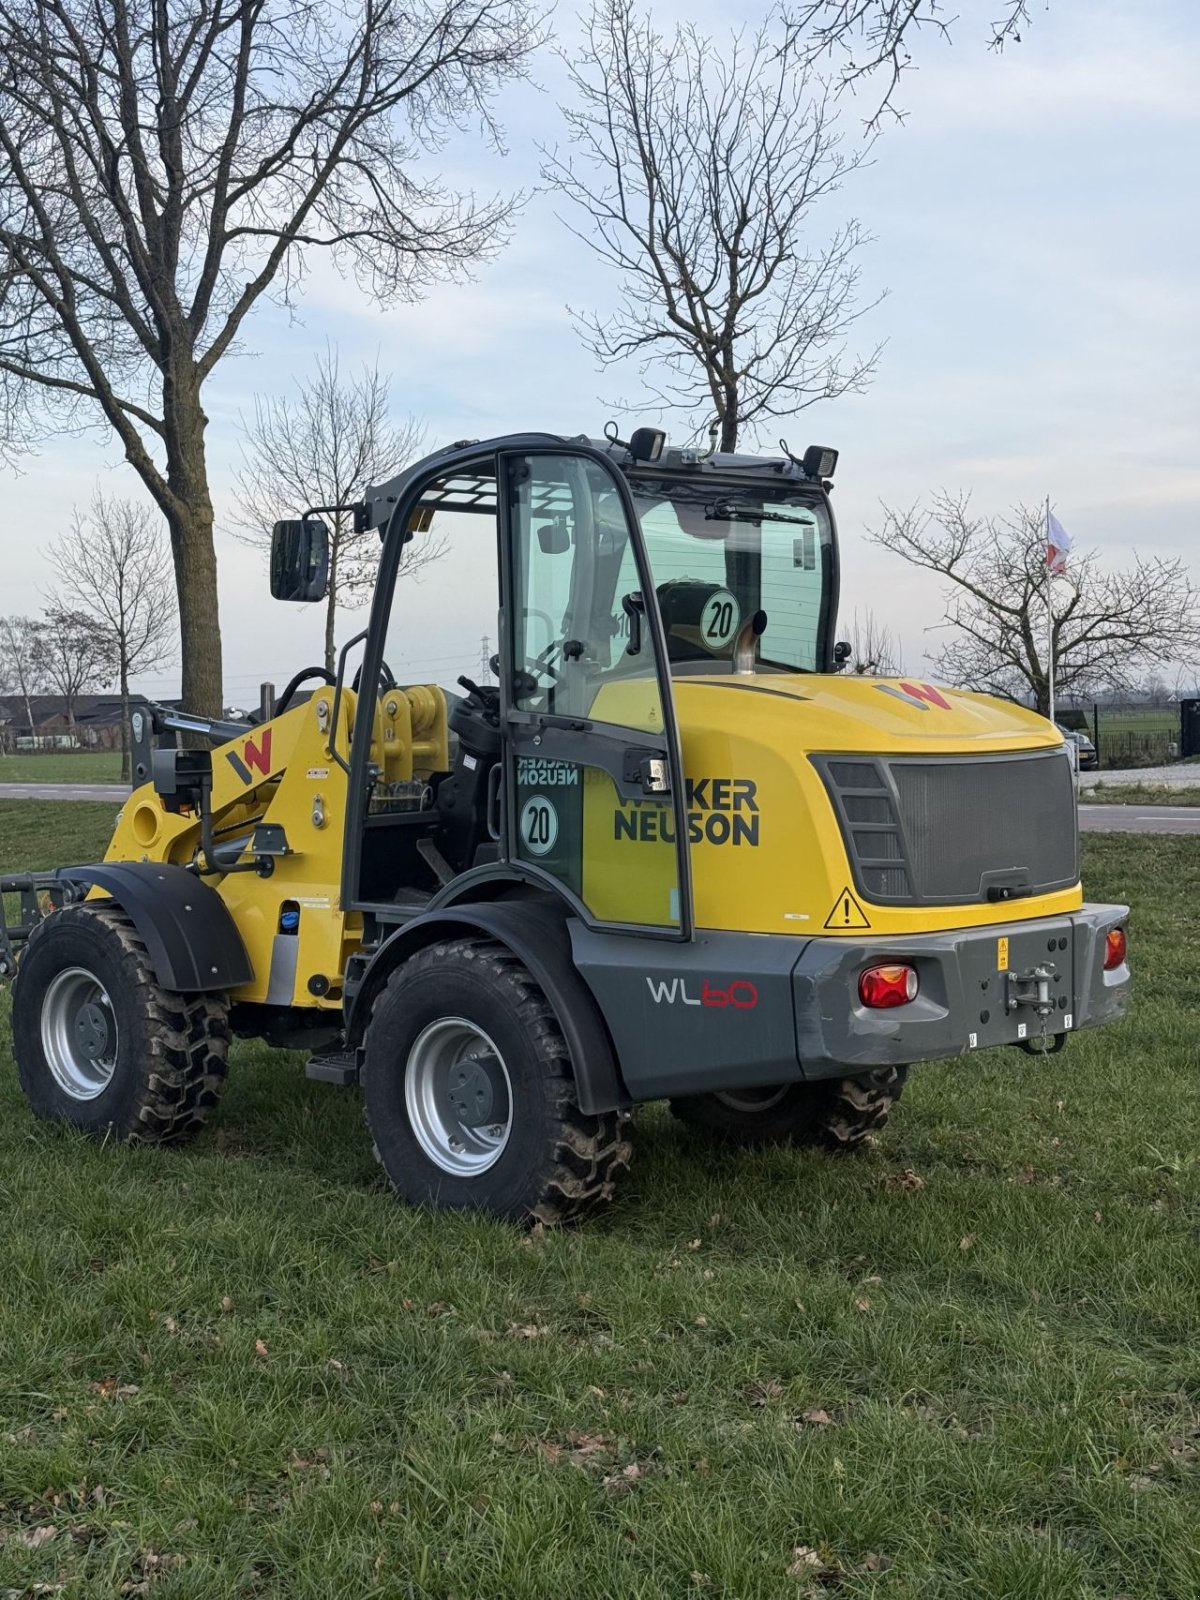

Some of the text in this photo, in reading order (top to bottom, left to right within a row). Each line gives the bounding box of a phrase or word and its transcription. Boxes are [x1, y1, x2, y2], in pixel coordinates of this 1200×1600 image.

[707, 601, 732, 637] 20
[619, 778, 759, 811] KER
[528, 806, 549, 844] 20
[614, 809, 759, 847] NEUSON
[646, 976, 758, 1008] WL60
